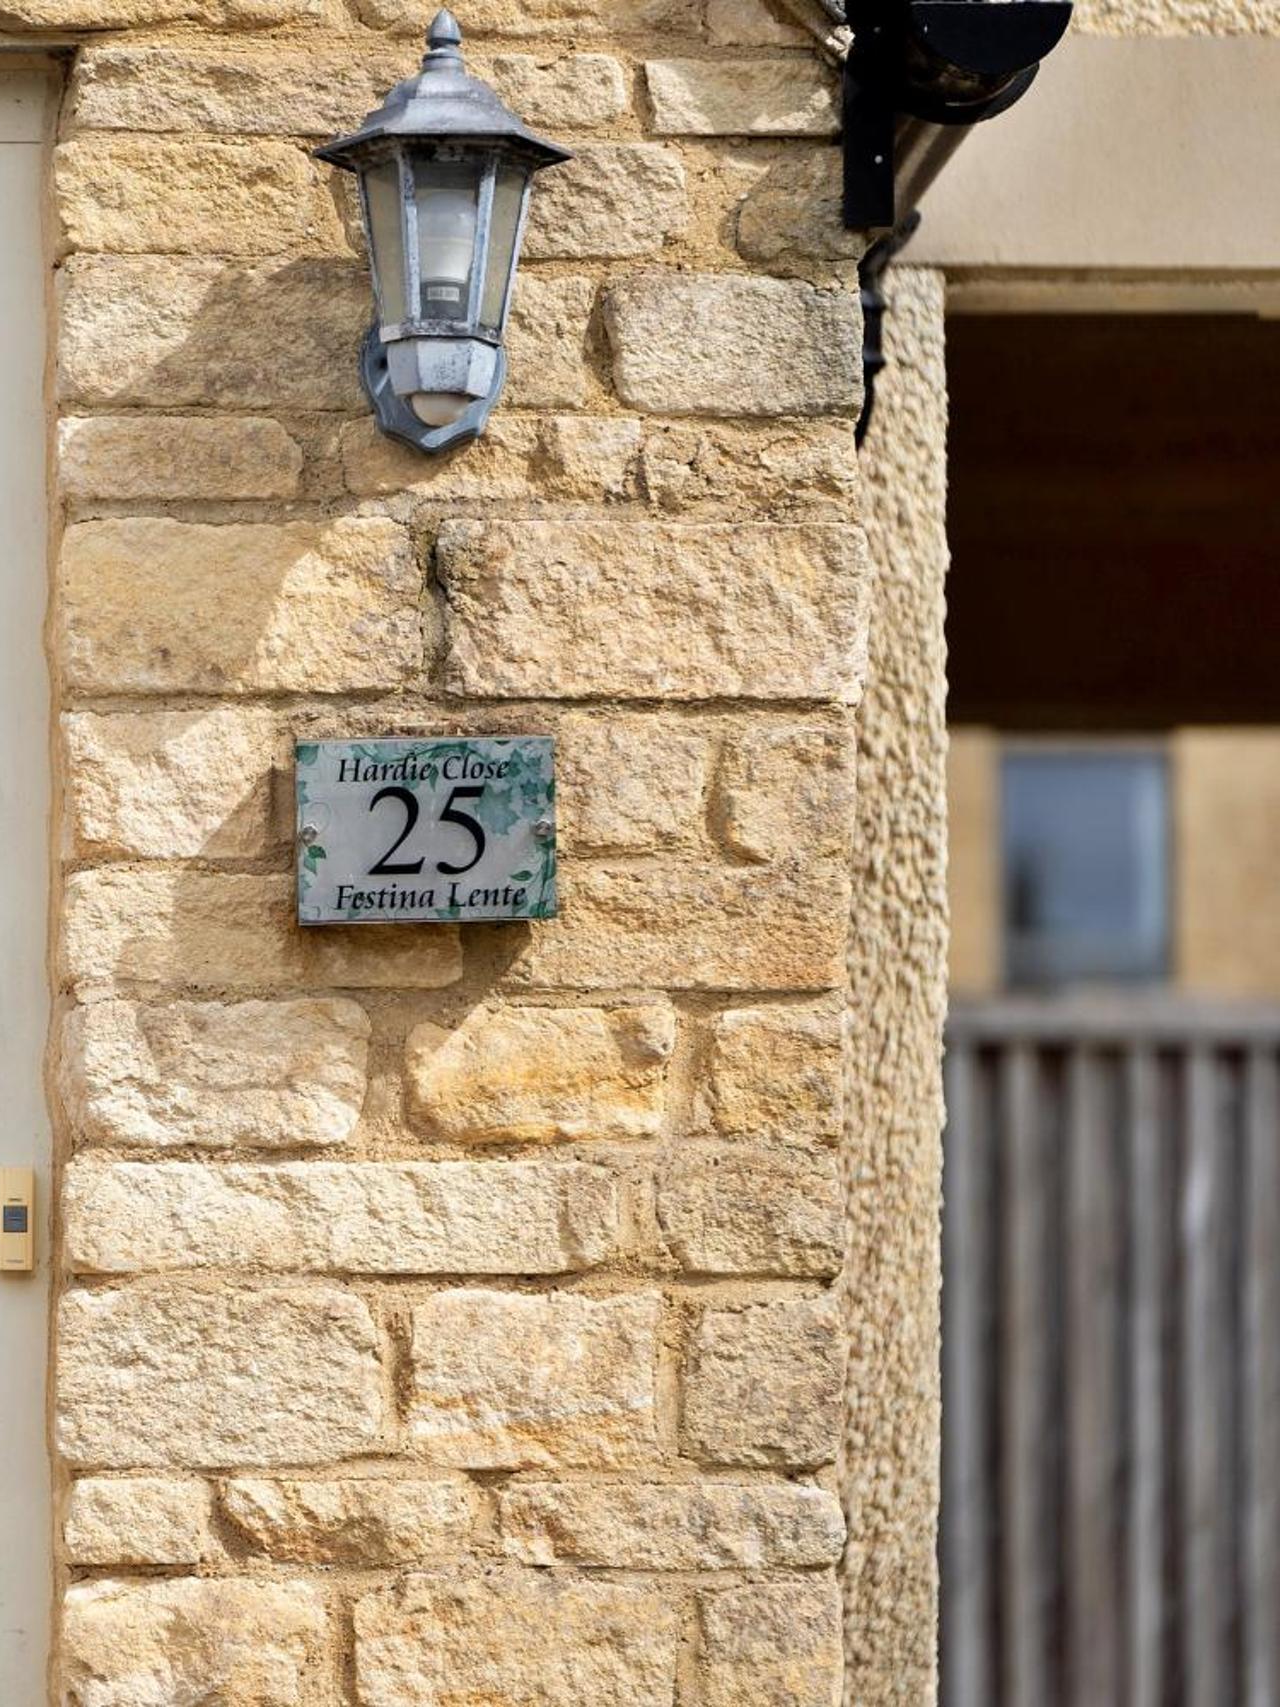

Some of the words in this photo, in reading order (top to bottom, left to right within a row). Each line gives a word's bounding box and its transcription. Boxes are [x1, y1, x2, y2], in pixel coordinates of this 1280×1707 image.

[337, 753, 431, 782] Hardie
[443, 755, 510, 779] Close
[368, 786, 485, 875] 25
[336, 884, 435, 910] Festina
[448, 882, 526, 907] Lente
